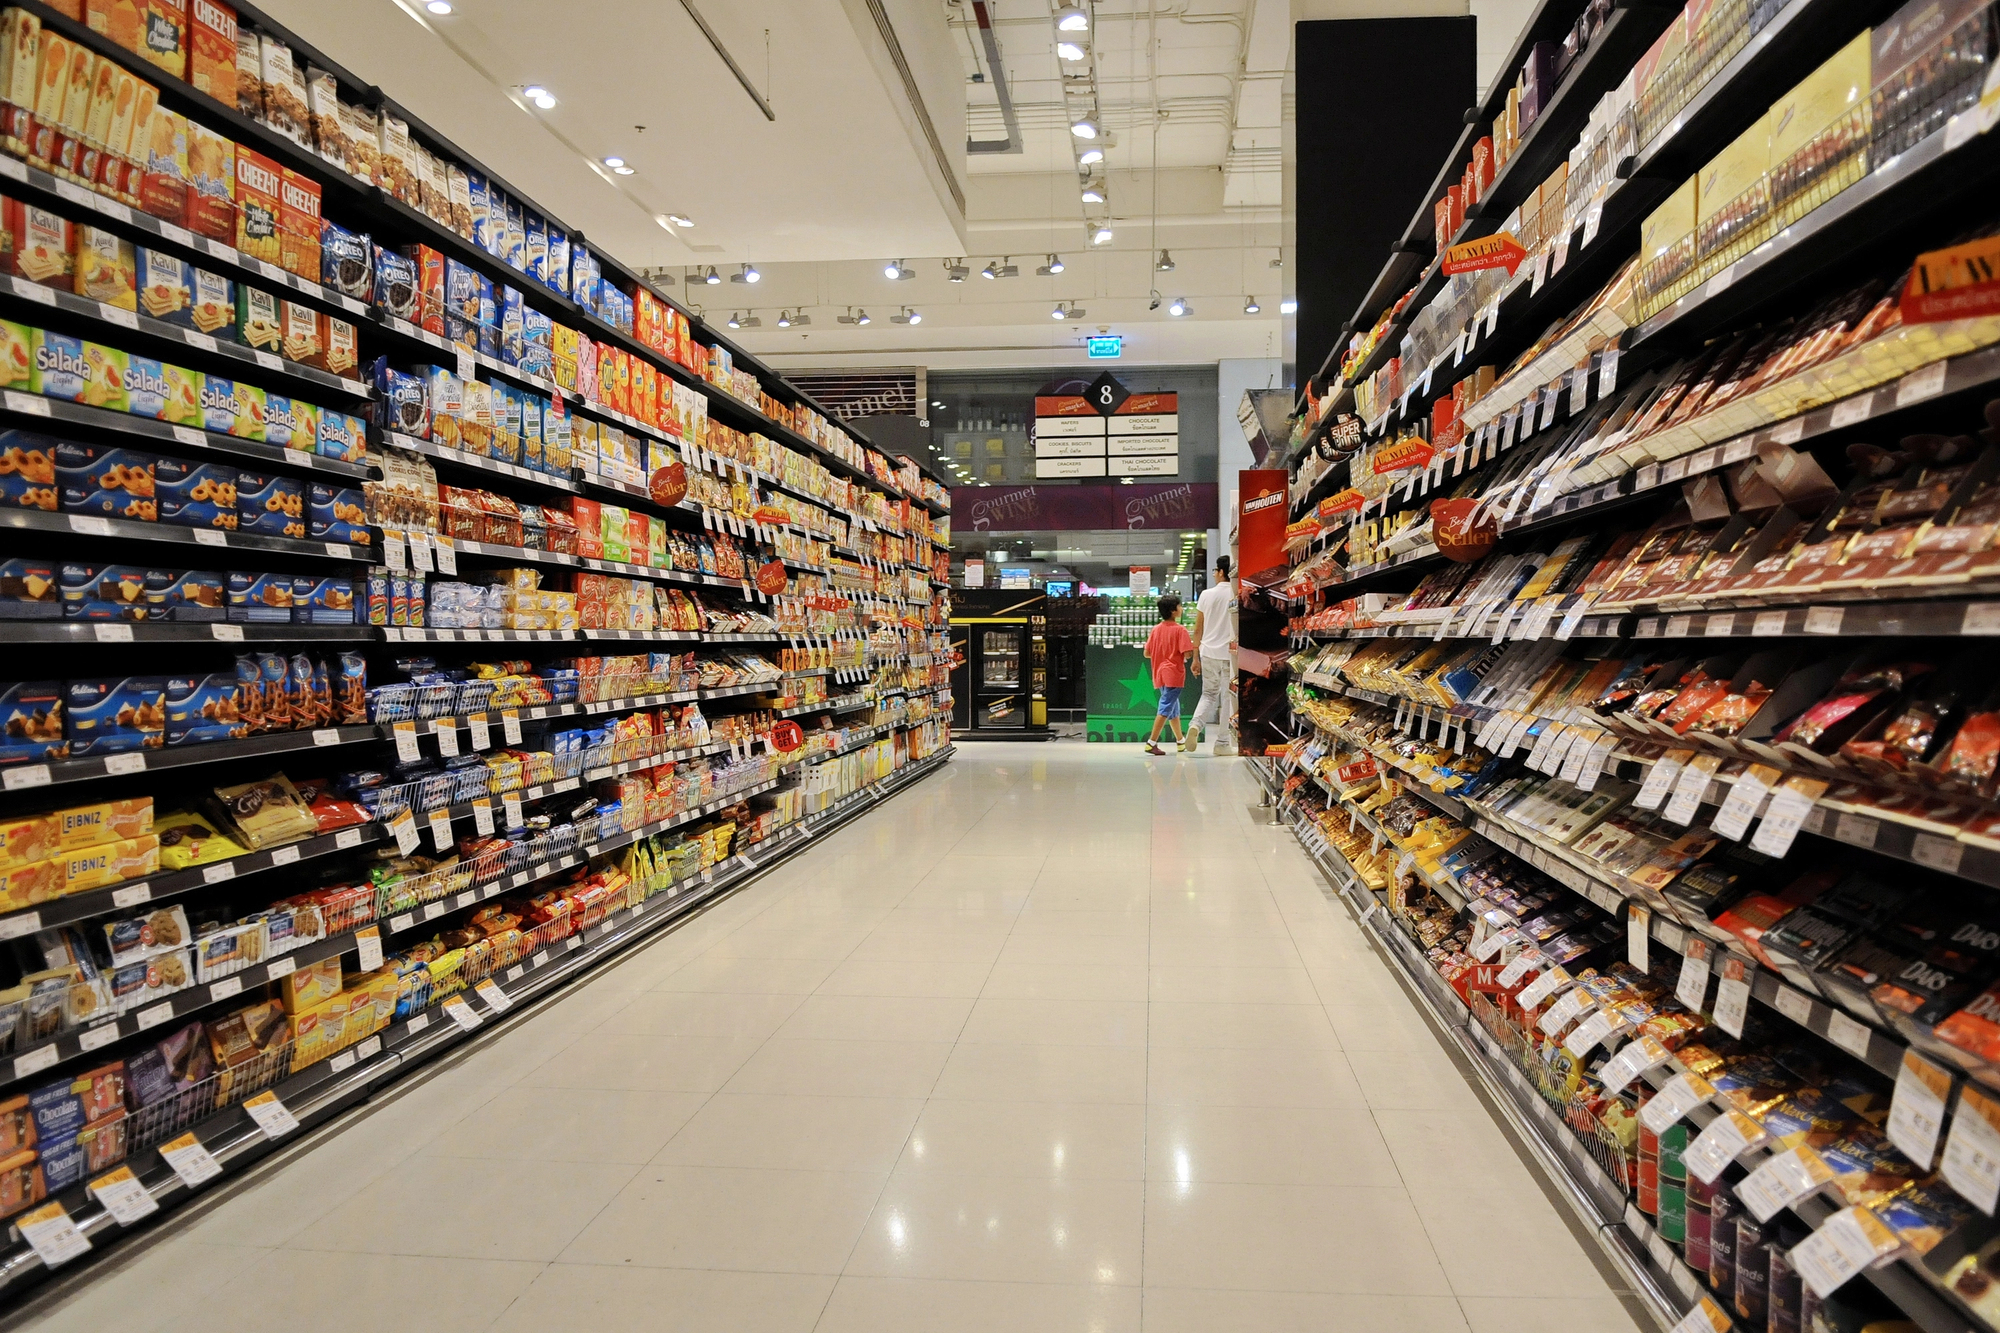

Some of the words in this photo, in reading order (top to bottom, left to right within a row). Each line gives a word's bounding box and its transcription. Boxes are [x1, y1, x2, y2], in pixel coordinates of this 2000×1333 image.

[237, 158, 280, 199] CHEEZ-IT
[281, 180, 320, 218] CHEEZ-IT
[30, 206, 60, 232] Kavli
[150, 250, 178, 273] Kavli
[200, 270, 224, 292] Kavli
[384, 267, 410, 284] OREO
[250, 288, 272, 308] Kavli
[291, 303, 313, 322] Kavli
[332, 318, 350, 335] Kavli
[526, 316, 549, 330] OREO
[36, 346, 92, 382] Salada
[122, 368, 171, 400] Salada
[1100, 384, 1113, 404] 8
[200, 386, 241, 417] Salada
[396, 388, 421, 401] OREO
[1138, 399, 1159, 410] market
[1065, 401, 1086, 411] market
[262, 404, 297, 431] Salada
[320, 422, 350, 448] Salada
[1331, 422, 1361, 439] SUPER
[1332, 434, 1362, 448] POINT
[654, 482, 687, 500] Seller
[657, 475, 672, 489] Best
[990, 496, 1039, 523] WINE
[1143, 494, 1195, 521] WINE
[1245, 501, 1255, 511] VAN
[1255, 492, 1283, 510] HOUTEN
[760, 575, 787, 591] Seller
[762, 571, 773, 582] Best
[775, 728, 791, 740] BUY
[790, 728, 798, 744] 1
[777, 737, 791, 748] GET
[1341, 766, 1351, 779] M
[1351, 762, 1372, 777] PRICE
[237, 785, 268, 814] Crush
[62, 811, 101, 834] LEIBNIZ
[67, 856, 106, 879] LEIBNIZ
[1477, 966, 1492, 986] M
[38, 1099, 78, 1121] Chocolate
